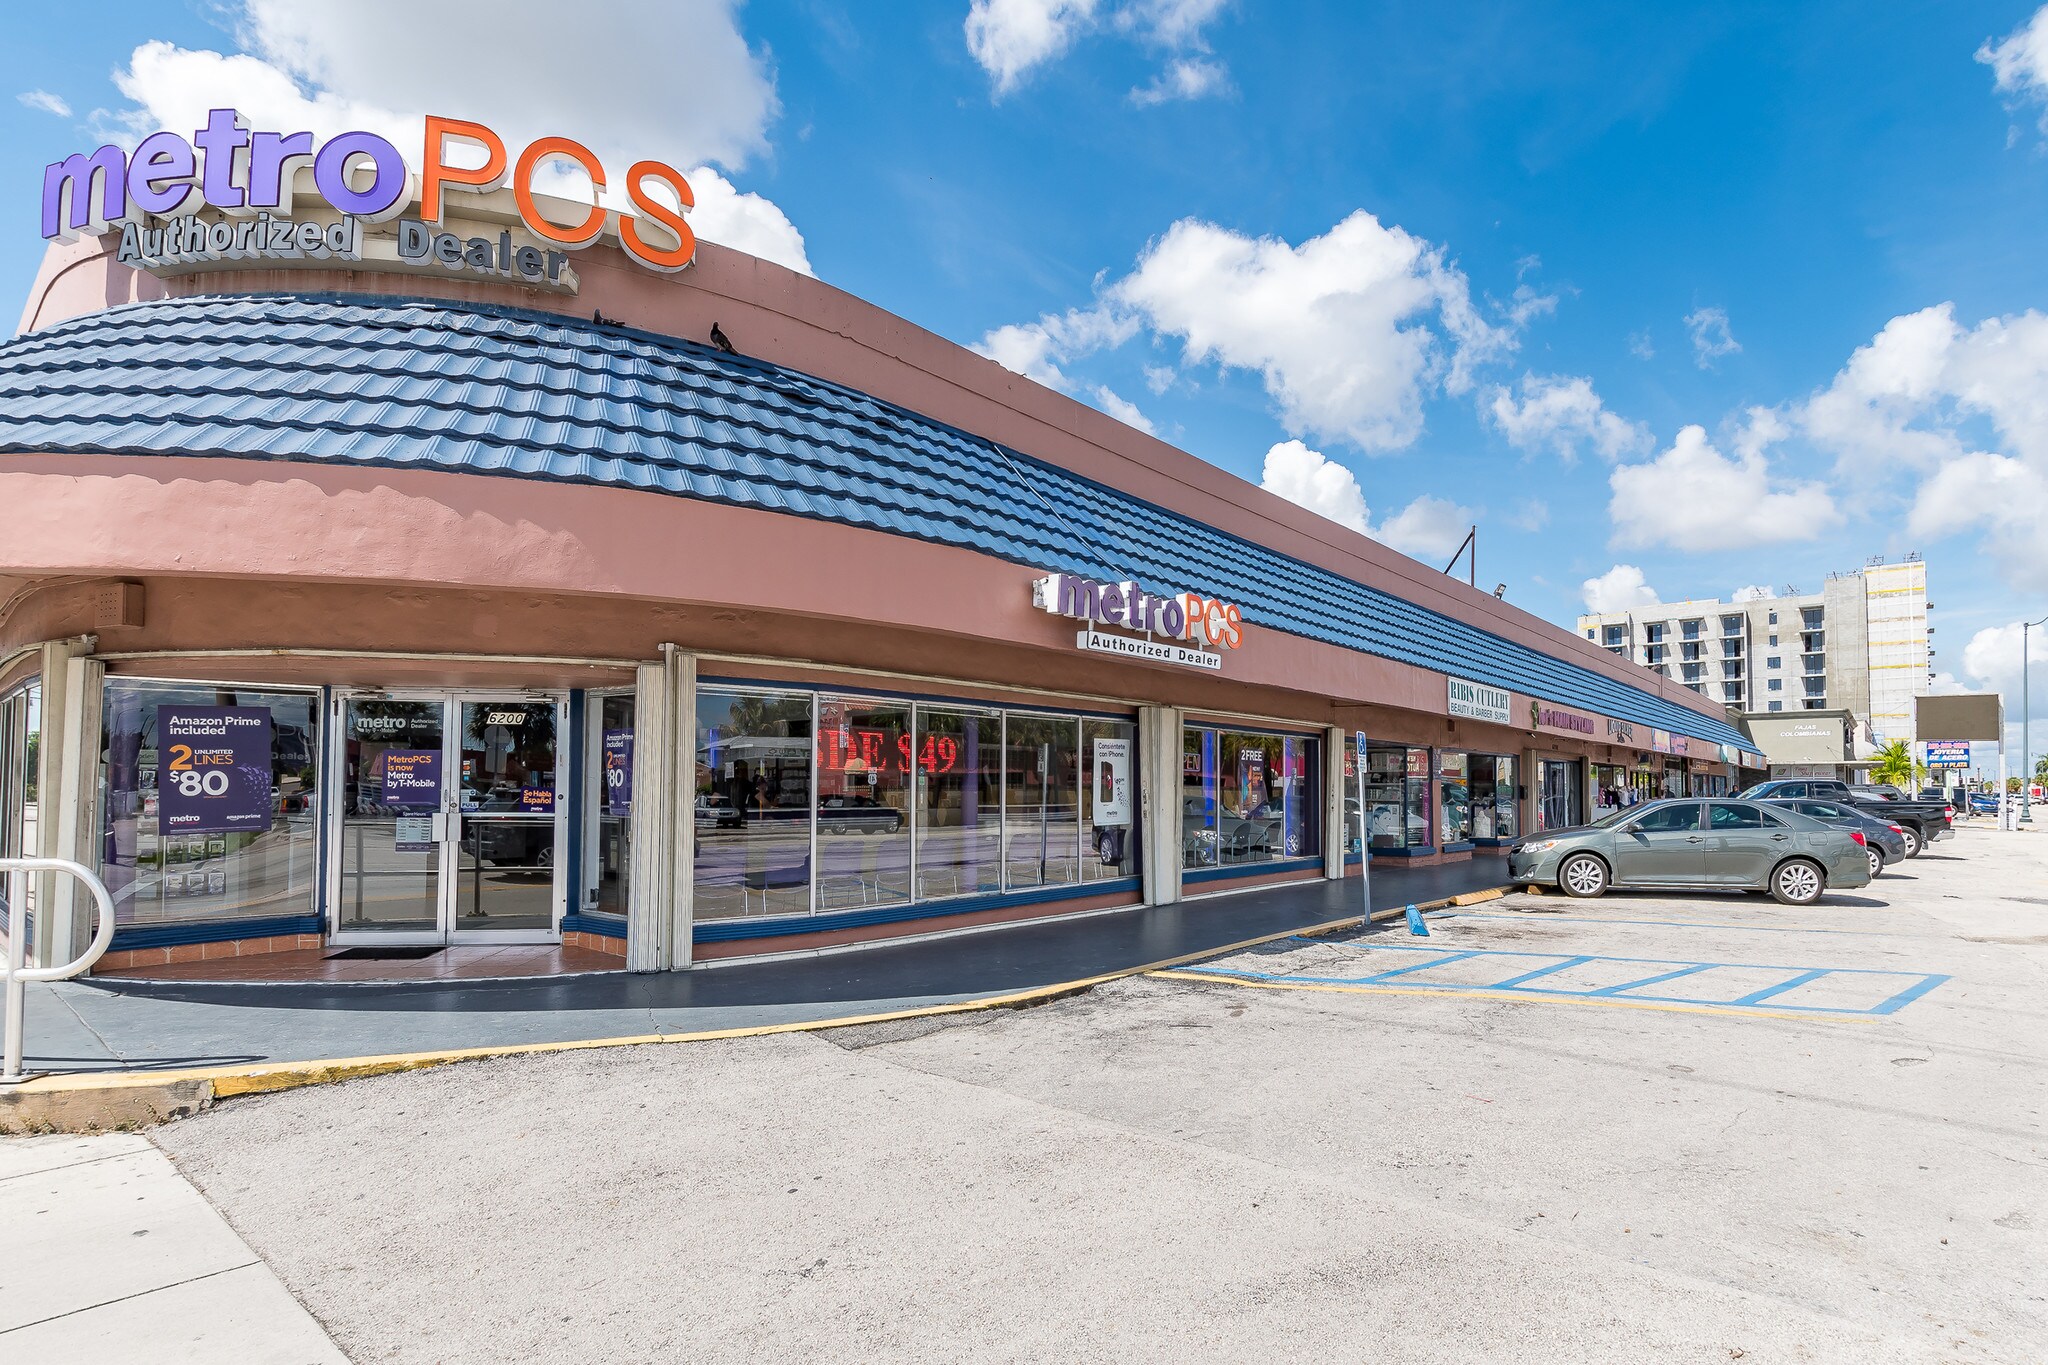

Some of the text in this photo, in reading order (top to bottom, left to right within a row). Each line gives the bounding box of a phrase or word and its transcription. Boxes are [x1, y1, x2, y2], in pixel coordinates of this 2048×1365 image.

[42, 107, 696, 270] metroPCS
[116, 212, 569, 283] Authorized Dealer
[1057, 573, 1243, 649] metroPCS
[1091, 634, 1219, 667] Authorized Dealer
[1476, 688, 1509, 710] CUTLERY
[1450, 702, 1509, 721] BEAUTY & BARBER SUPPLY
[169, 716, 261, 726] Amazon Prime
[357, 716, 406, 729] metro
[489, 713, 523, 724] 6200
[169, 725, 226, 735] included
[169, 744, 192, 770] 2
[194, 754, 234, 765] LINES
[387, 755, 432, 763] MetroPCS
[607, 751, 613, 769] 2
[1241, 749, 1263, 761] 2 FREE
[387, 763, 394, 771] is
[169, 770, 229, 797] $80
[387, 779, 436, 788] by T-Mobile
[523, 796, 552, 805] Español
[169, 815, 200, 825] metro
